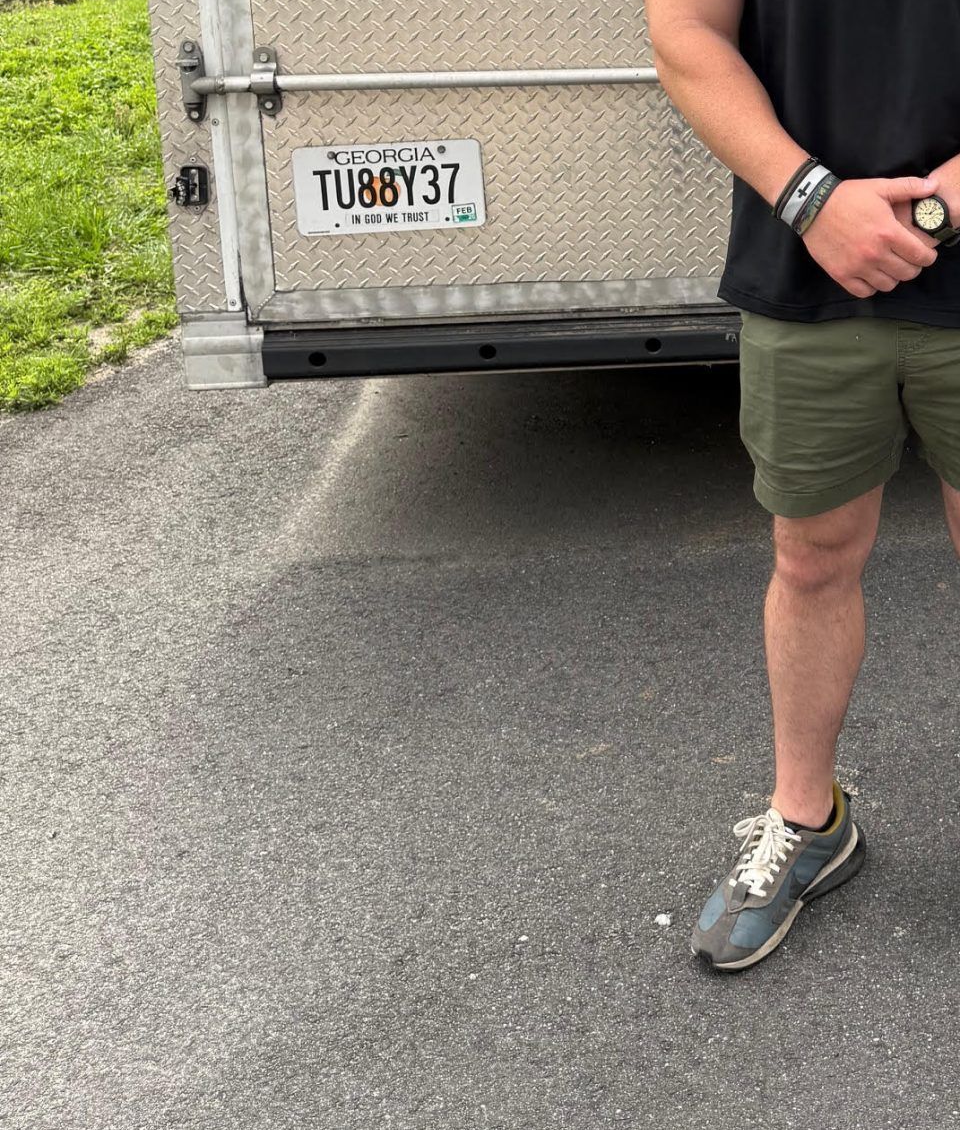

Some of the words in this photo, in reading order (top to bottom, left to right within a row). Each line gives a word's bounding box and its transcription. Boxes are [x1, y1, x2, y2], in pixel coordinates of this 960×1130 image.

[334, 147, 436, 166] GEORGIA
[312, 163, 460, 211] TU88Y37
[351, 214, 362, 225] IN
[365, 213, 383, 225] GOD
[385, 213, 400, 224] WE
[402, 211, 430, 223] TRUST
[456, 206, 473, 215] FEB
